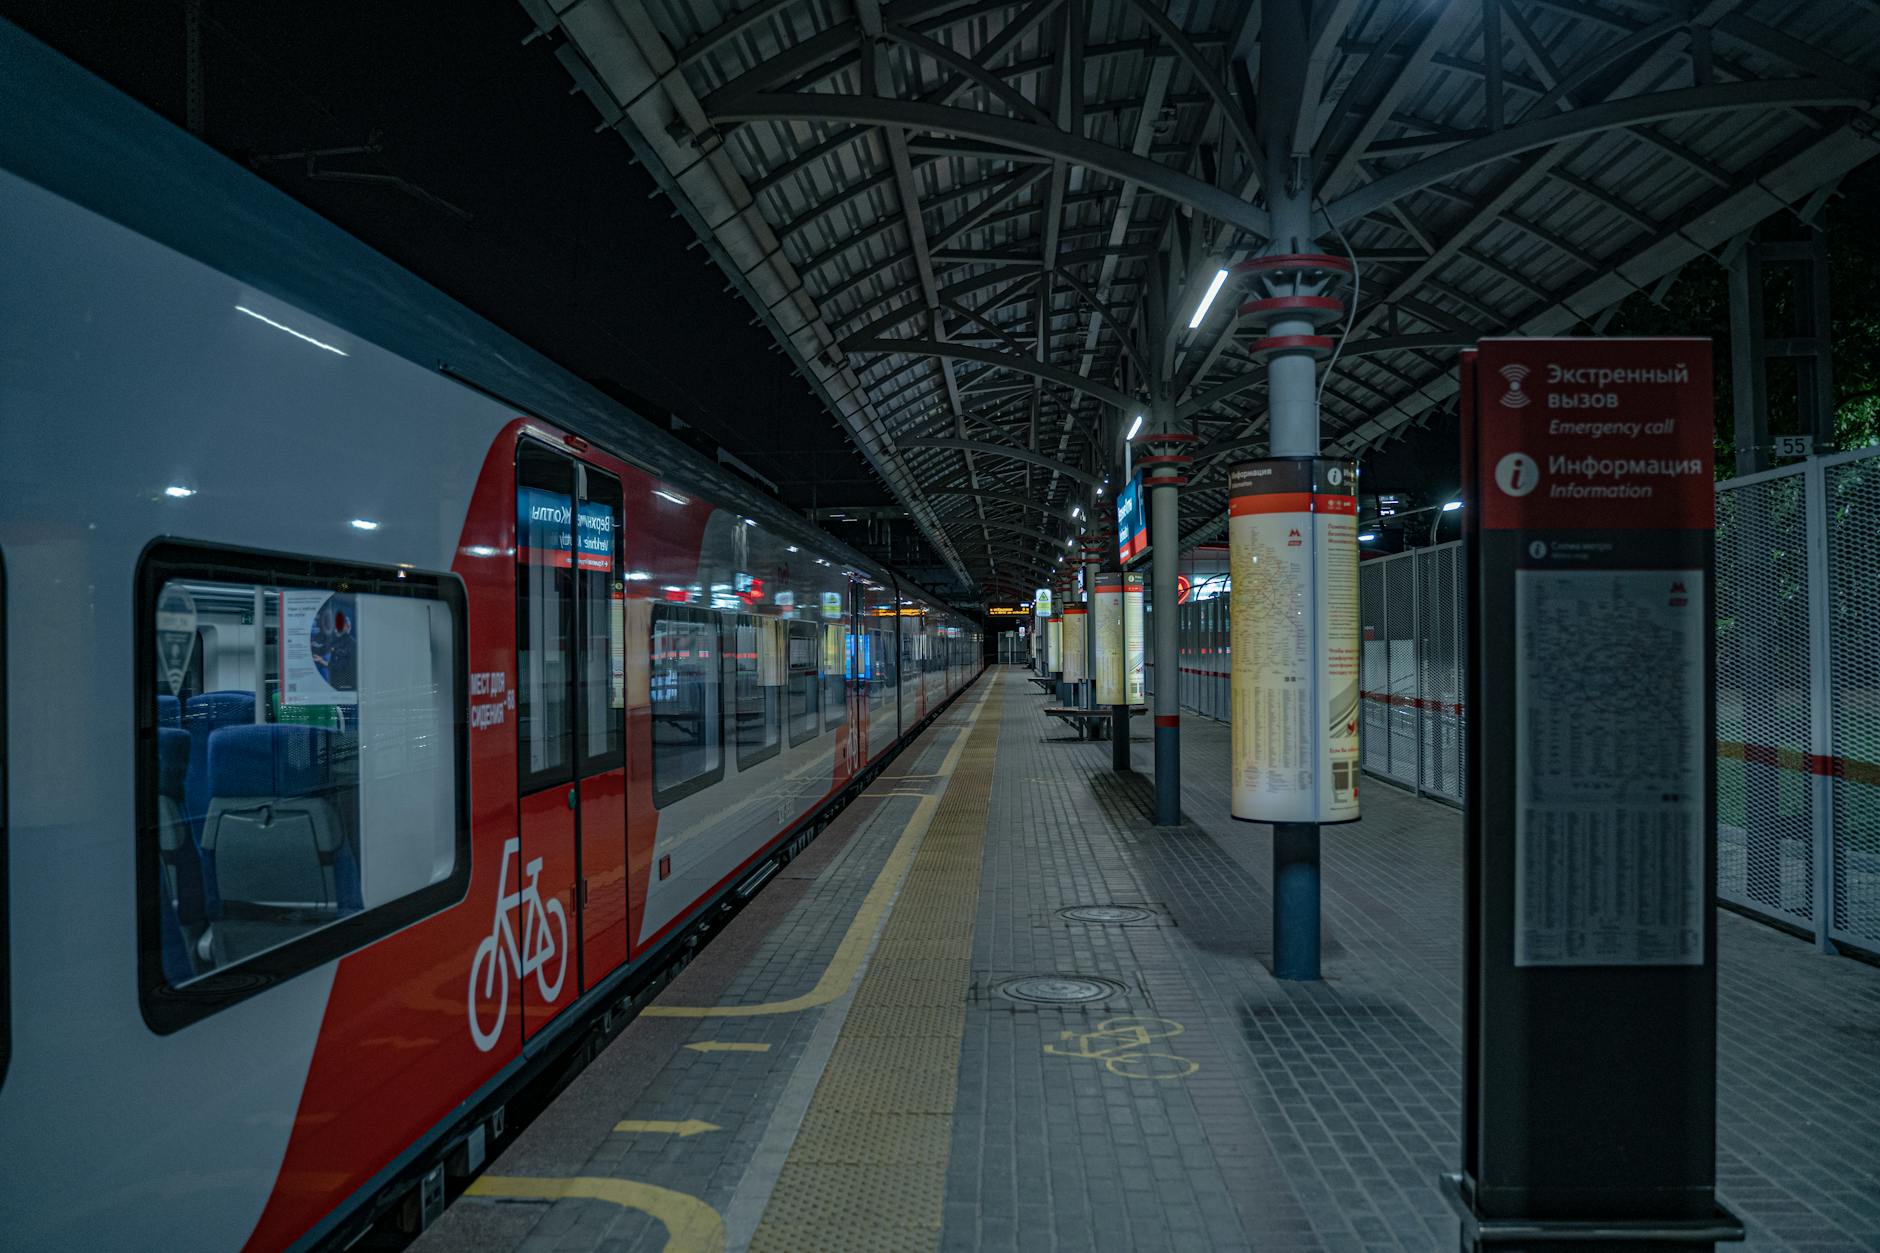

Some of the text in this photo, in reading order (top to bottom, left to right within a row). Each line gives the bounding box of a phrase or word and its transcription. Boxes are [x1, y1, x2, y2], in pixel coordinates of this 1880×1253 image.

[1546, 363, 1689, 388] Экстренный
[1548, 394, 1619, 409] вызов
[1549, 419, 1675, 438] Emergency call
[1783, 438, 1805, 454] 55
[1549, 455, 1702, 478] Информация
[1550, 483, 1653, 498] Information
